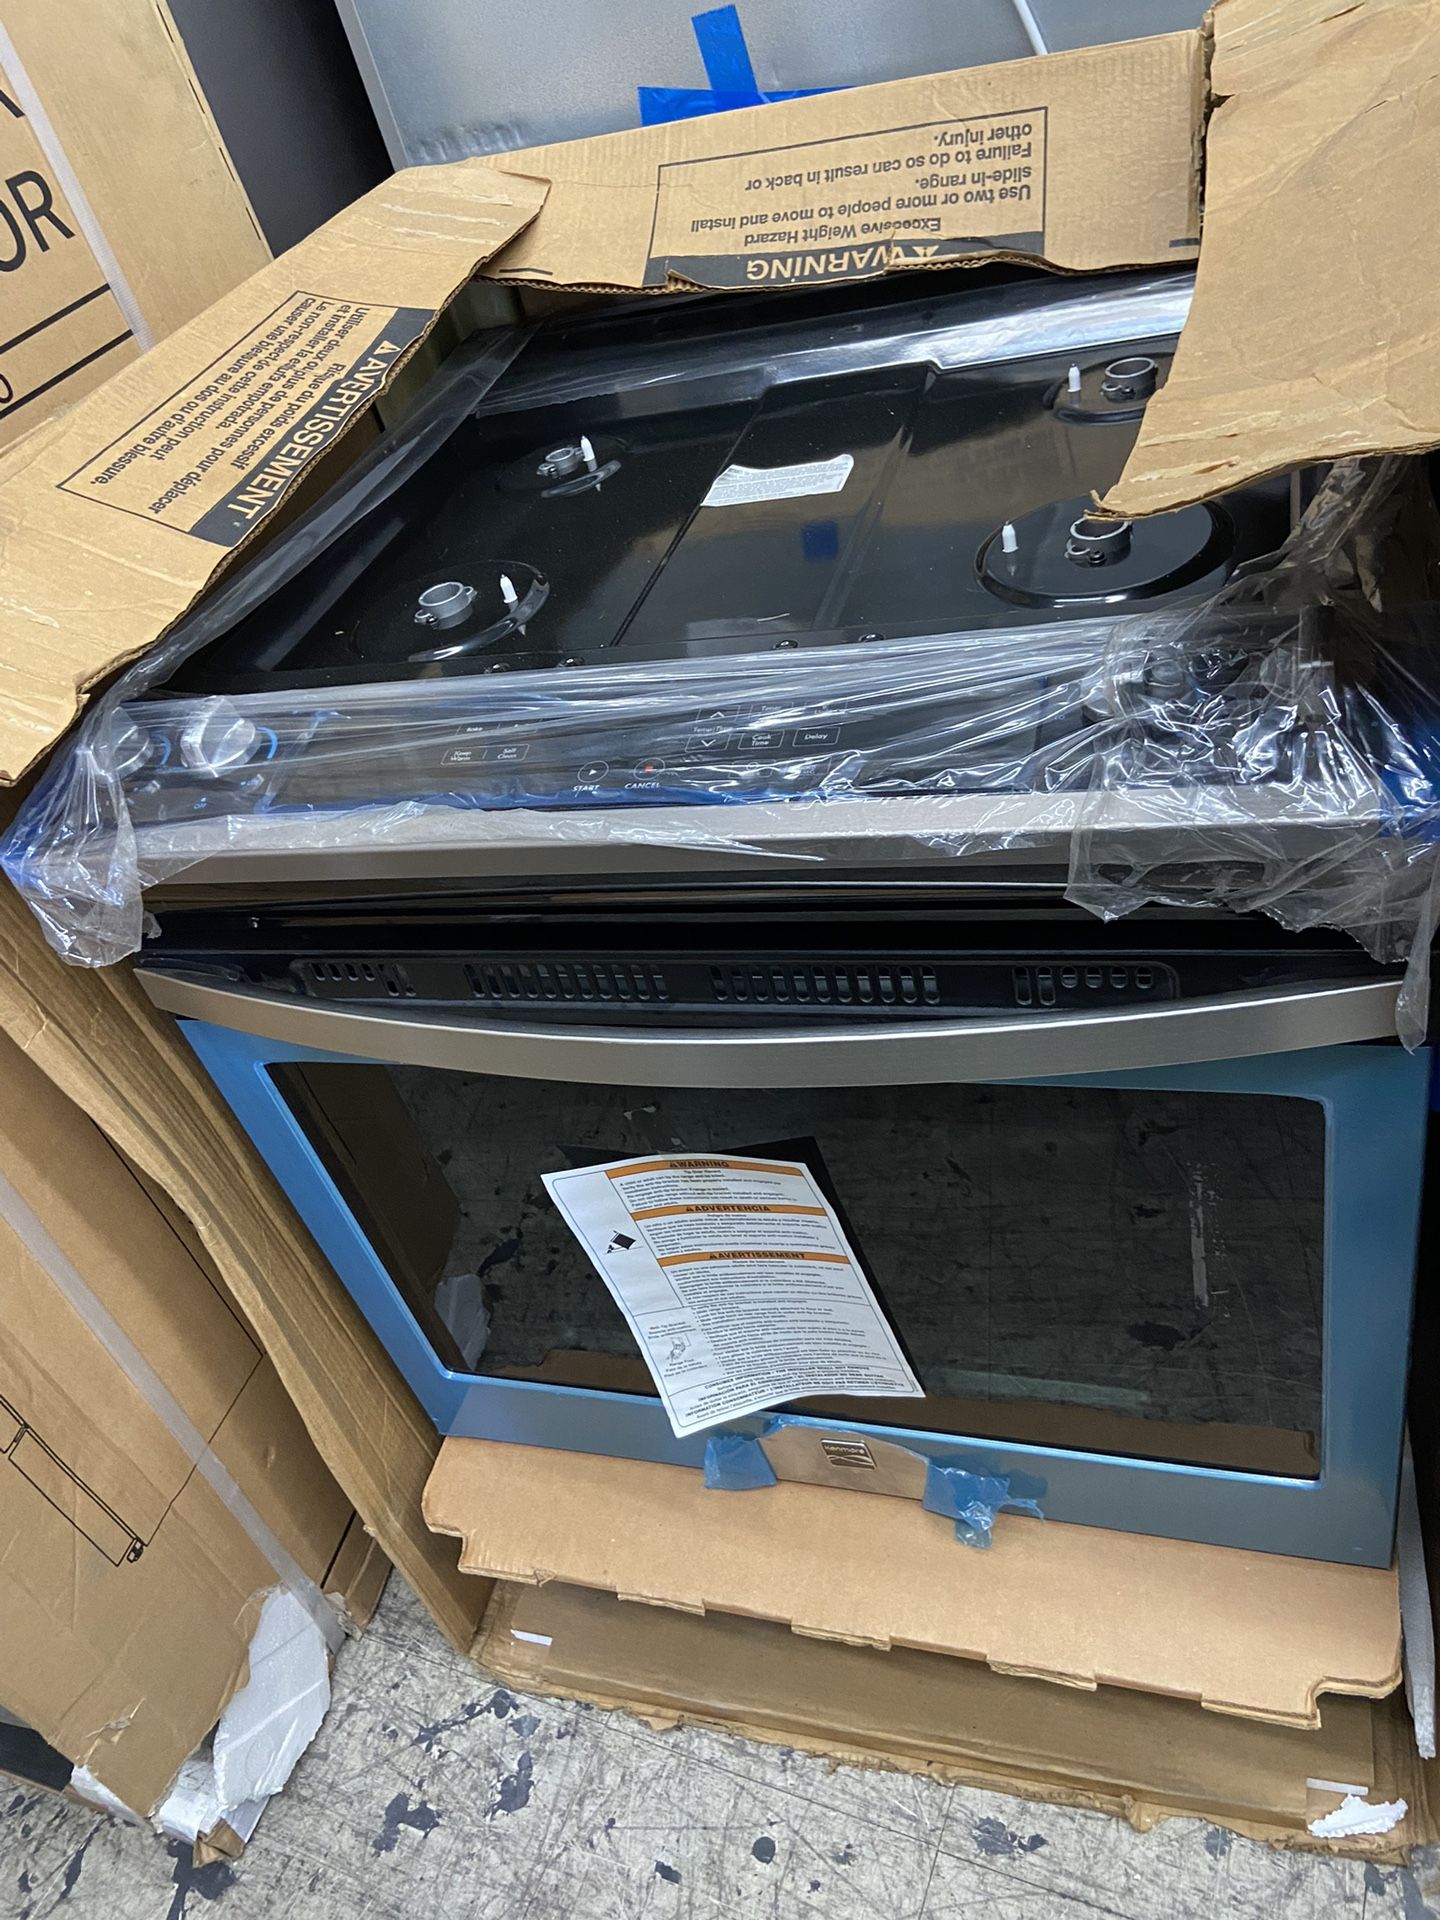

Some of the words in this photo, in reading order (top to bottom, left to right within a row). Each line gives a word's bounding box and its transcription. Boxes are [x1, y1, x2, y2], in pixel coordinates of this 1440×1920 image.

[746, 179, 762, 191] or
[988, 124, 1032, 141] other
[930, 152, 950, 167] do
[955, 150, 971, 164] to
[976, 143, 1032, 160] Failure
[873, 159, 901, 173] can
[906, 156, 925, 169] so
[766, 174, 802, 188] back
[807, 172, 820, 183] in
[826, 164, 868, 182] result
[972, 167, 1032, 186] slide-in
[915, 174, 966, 190] range.
[942, 194, 959, 205] or
[964, 189, 994, 204] two
[999, 185, 1031, 200] Use
[838, 196, 891, 217] people
[896, 195, 937, 210] more
[772, 209, 814, 223] move
[818, 207, 833, 219] to
[691, 218, 736, 232] install
[740, 215, 768, 228] and
[861, 218, 941, 234] Excessive
[744, 230, 798, 246] Hazard
[802, 224, 856, 240] Weight
[747, 246, 905, 280] WARNING
[283, 297, 316, 325] causer
[315, 300, 335, 311] Le
[336, 304, 351, 314] et
[334, 307, 370, 339] Utiliser
[264, 311, 320, 360] non-respect
[265, 324, 288, 340] une
[305, 314, 346, 349] installer
[294, 348, 314, 358] la
[312, 339, 340, 361] deux
[252, 359, 270, 370] de
[212, 372, 232, 385] au
[227, 370, 256, 393] cette
[281, 369, 306, 389] plus
[193, 384, 219, 401] dos
[268, 390, 288, 402] de
[294, 390, 314, 403] du
[178, 400, 199, 414] ou
[215, 382, 273, 428] empotrada.
[174, 393, 236, 438] instruction
[269, 402, 302, 427] poids
[142, 413, 185, 444] d'autre
[219, 401, 275, 448] personnes
[227, 357, 389, 519] AVERTISSEMENT
[149, 436, 181, 460] peut
[230, 428, 275, 469] excessif
[90, 443, 151, 484] blessure.
[195, 447, 226, 472] pour
[148, 471, 201, 513] déplacer
[718, 1251, 804, 1259] AVERTISSEMENT
